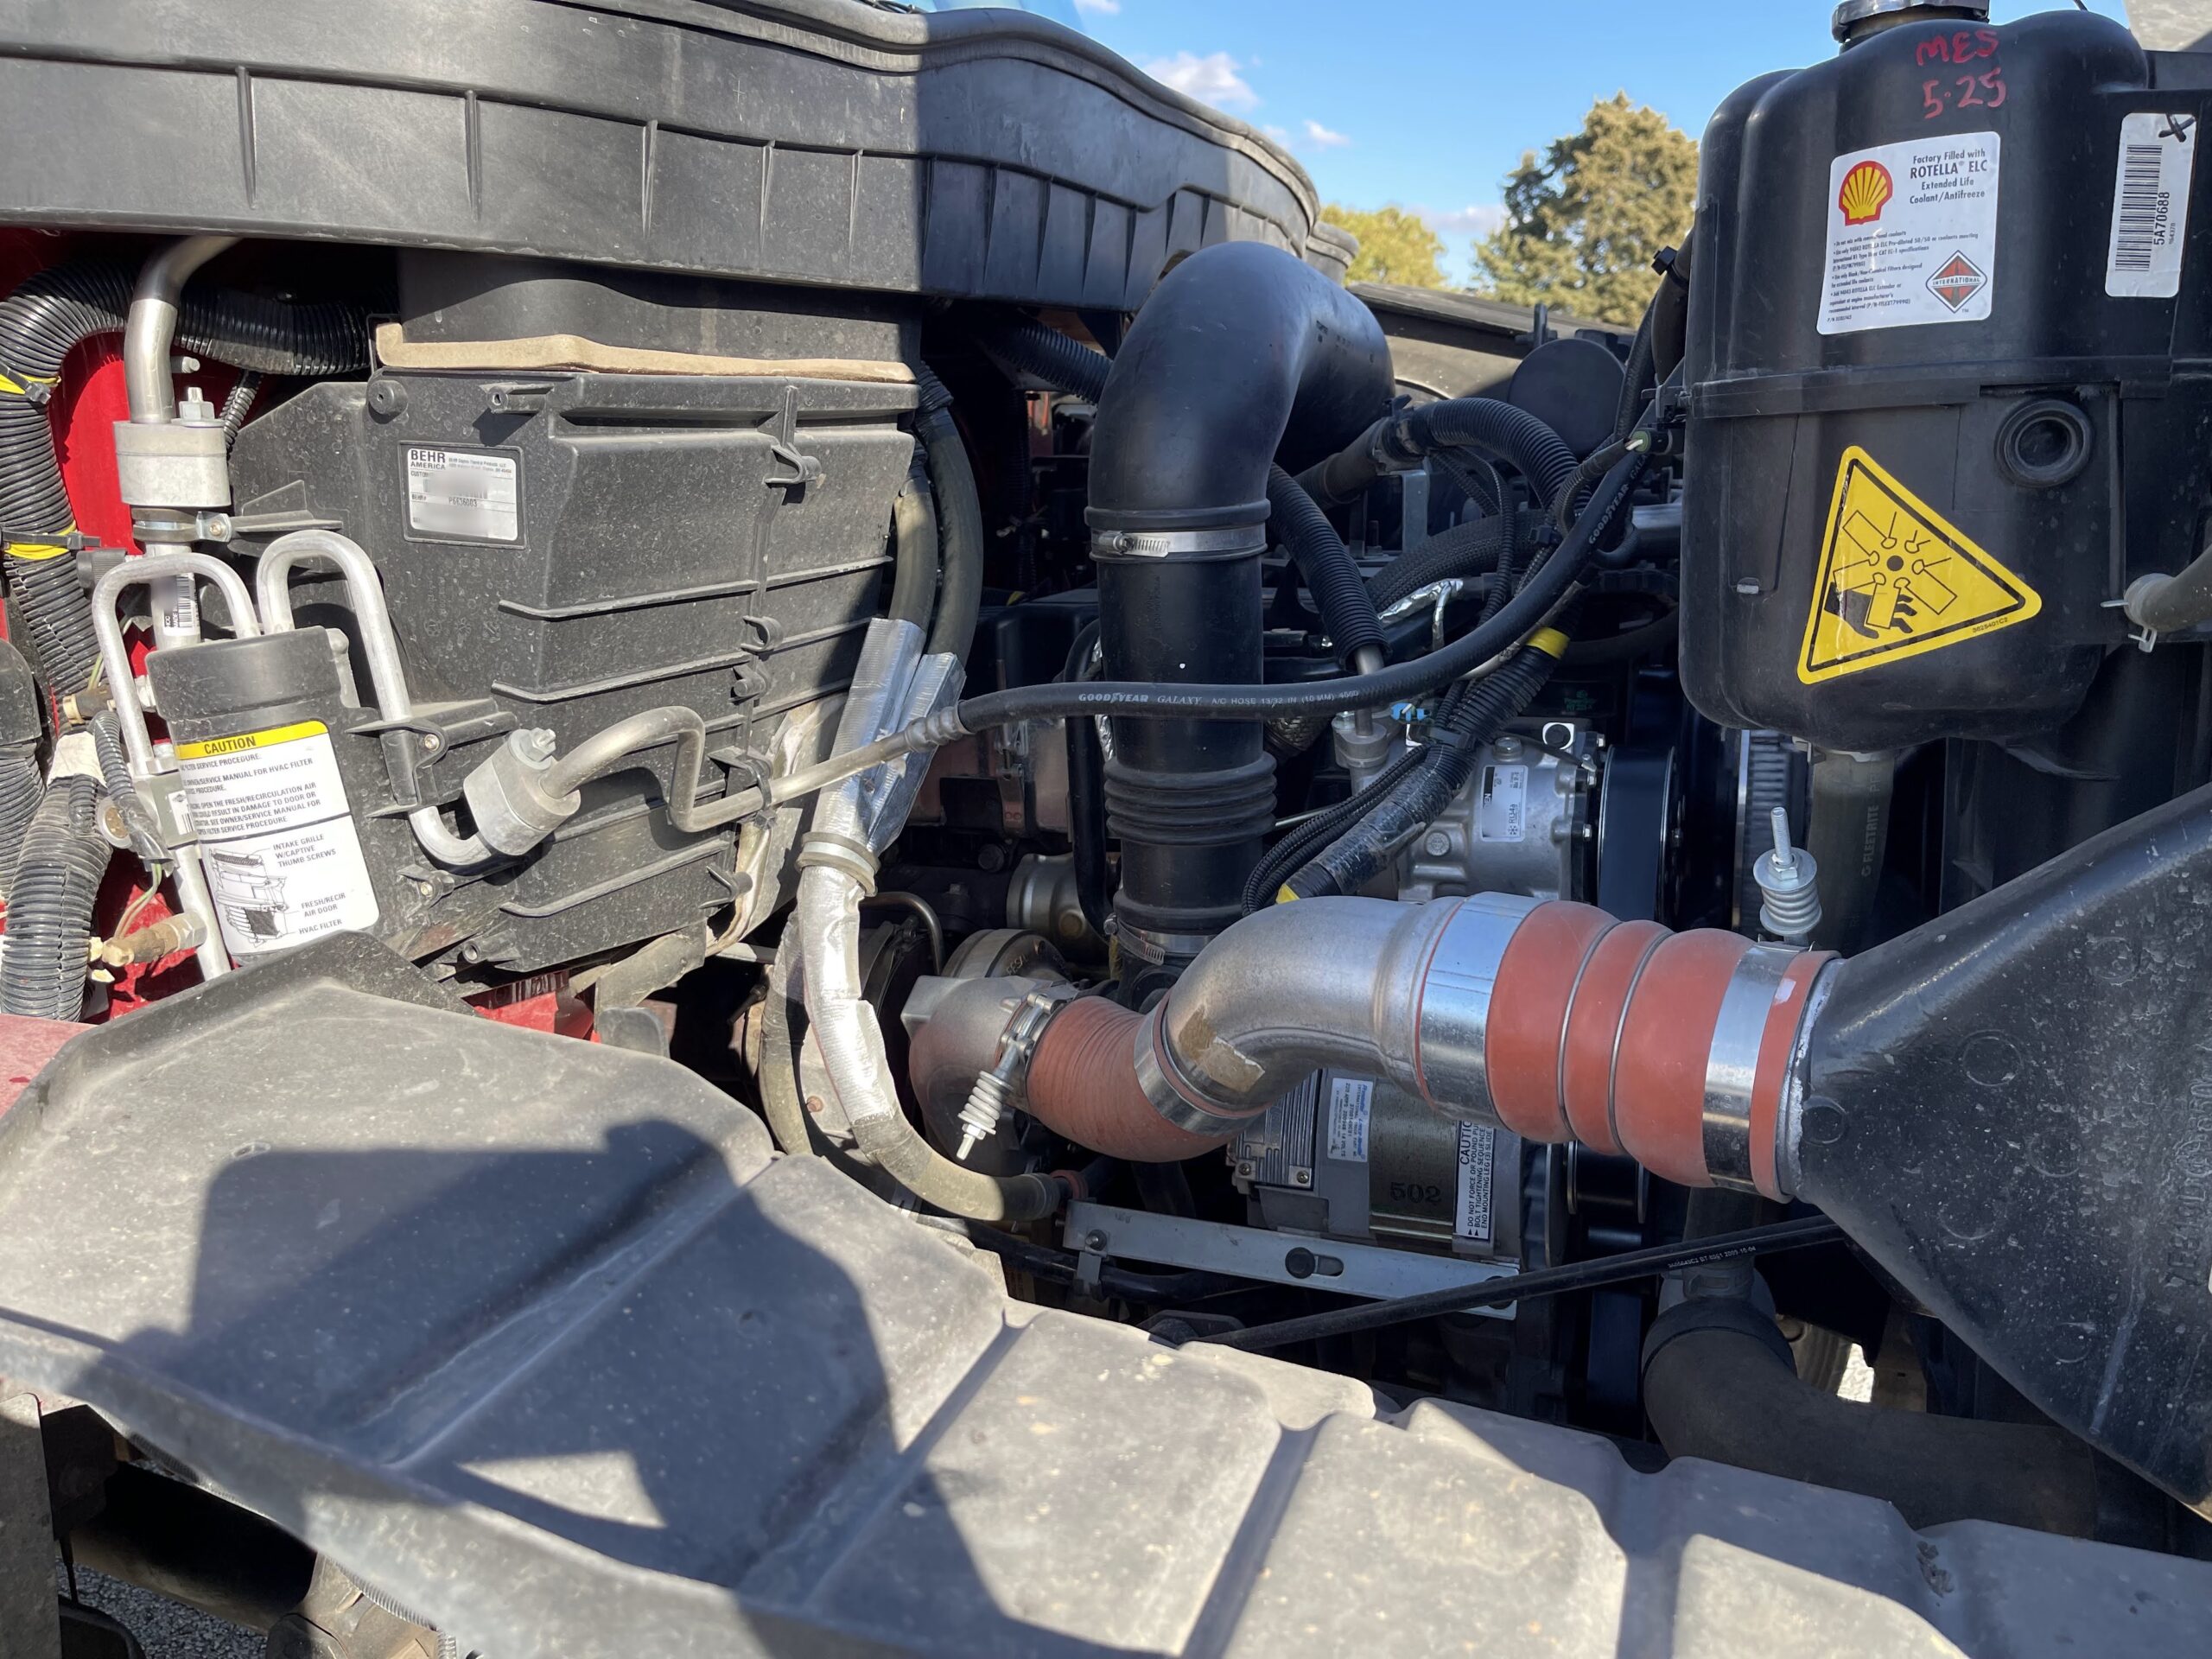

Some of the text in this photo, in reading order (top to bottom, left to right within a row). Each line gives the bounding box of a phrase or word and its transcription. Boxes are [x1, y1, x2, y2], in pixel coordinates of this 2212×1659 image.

[1916, 29, 1999, 66] MES
[1913, 148, 1985, 164] Factory Filled with
[1968, 160, 1987, 173] ELC
[1922, 176, 1974, 190] Extended Life
[1910, 190, 1985, 204] Coolant/Antifreeze
[2153, 192, 2170, 245] 5A70688
[1933, 276, 1980, 285] INTERNATIONAL
[411, 449, 446, 463] BEHR
[410, 461, 446, 470] AMERICA
[1589, 484, 1630, 544] GOODYEAR
[1078, 693, 1149, 703] GOODYEAR
[1157, 696, 1202, 705] GALAXY
[204, 735, 256, 754] CAUTION
[197, 760, 217, 770] SERVICE
[222, 770, 254, 780] MANUAL
[254, 767, 268, 776] FOR
[269, 763, 289, 773] HVAC
[290, 758, 313, 768] FILTER
[225, 785, 302, 807] FRESH/RECIRCULATION
[304, 782, 316, 791] AIR
[212, 808, 231, 817] RESULT
[241, 801, 271, 812] DAMAGE
[284, 794, 305, 804] DOOR
[219, 810, 272, 824] OWNER/SERVICE
[274, 804, 306, 815] MANUAL
[307, 799, 321, 808] FOR
[221, 823, 245, 833] SERVICE
[245, 816, 287, 830] PROCEDURE
[273, 834, 324, 850] INTAKE GRILLE
[1863, 805, 1879, 862] FLEETRITE
[275, 845, 315, 859] W/CAPTIVE
[278, 849, 336, 868] THUMB SCREWS
[301, 893, 346, 909] FRESH/RECIR
[304, 904, 338, 917] AIR DOOR
[298, 918, 342, 934] HVAC FILTER
[1460, 1121, 1472, 1165] CAUTIO
[1389, 1182, 1441, 1205] 502
[1467, 1217, 1473, 1227] DO
[1470, 1165, 1476, 1174] OR
[1475, 1166, 1484, 1211] TIGHTENING
